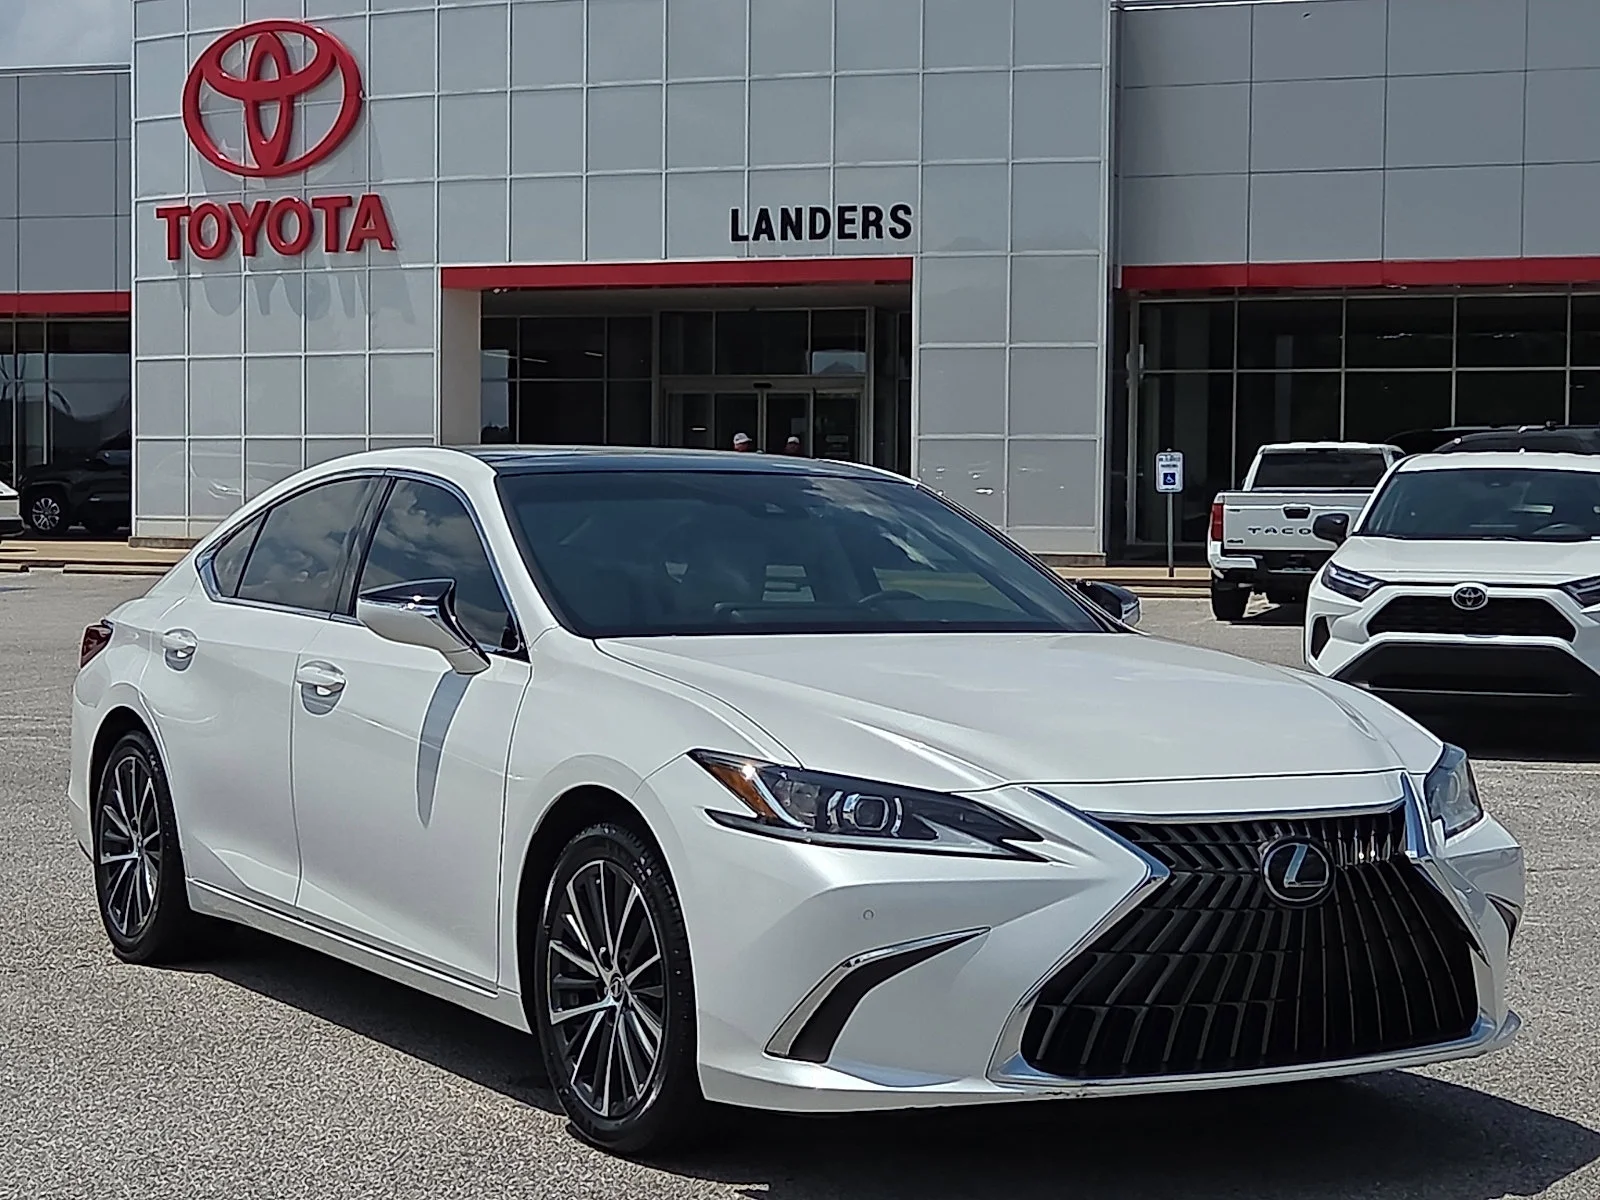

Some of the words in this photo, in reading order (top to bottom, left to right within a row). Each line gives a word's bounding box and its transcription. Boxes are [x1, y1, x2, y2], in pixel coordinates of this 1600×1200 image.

[155, 193, 397, 261] TOYOTA
[731, 203, 913, 242] LANDERS
[1247, 526, 1312, 536] TACO
